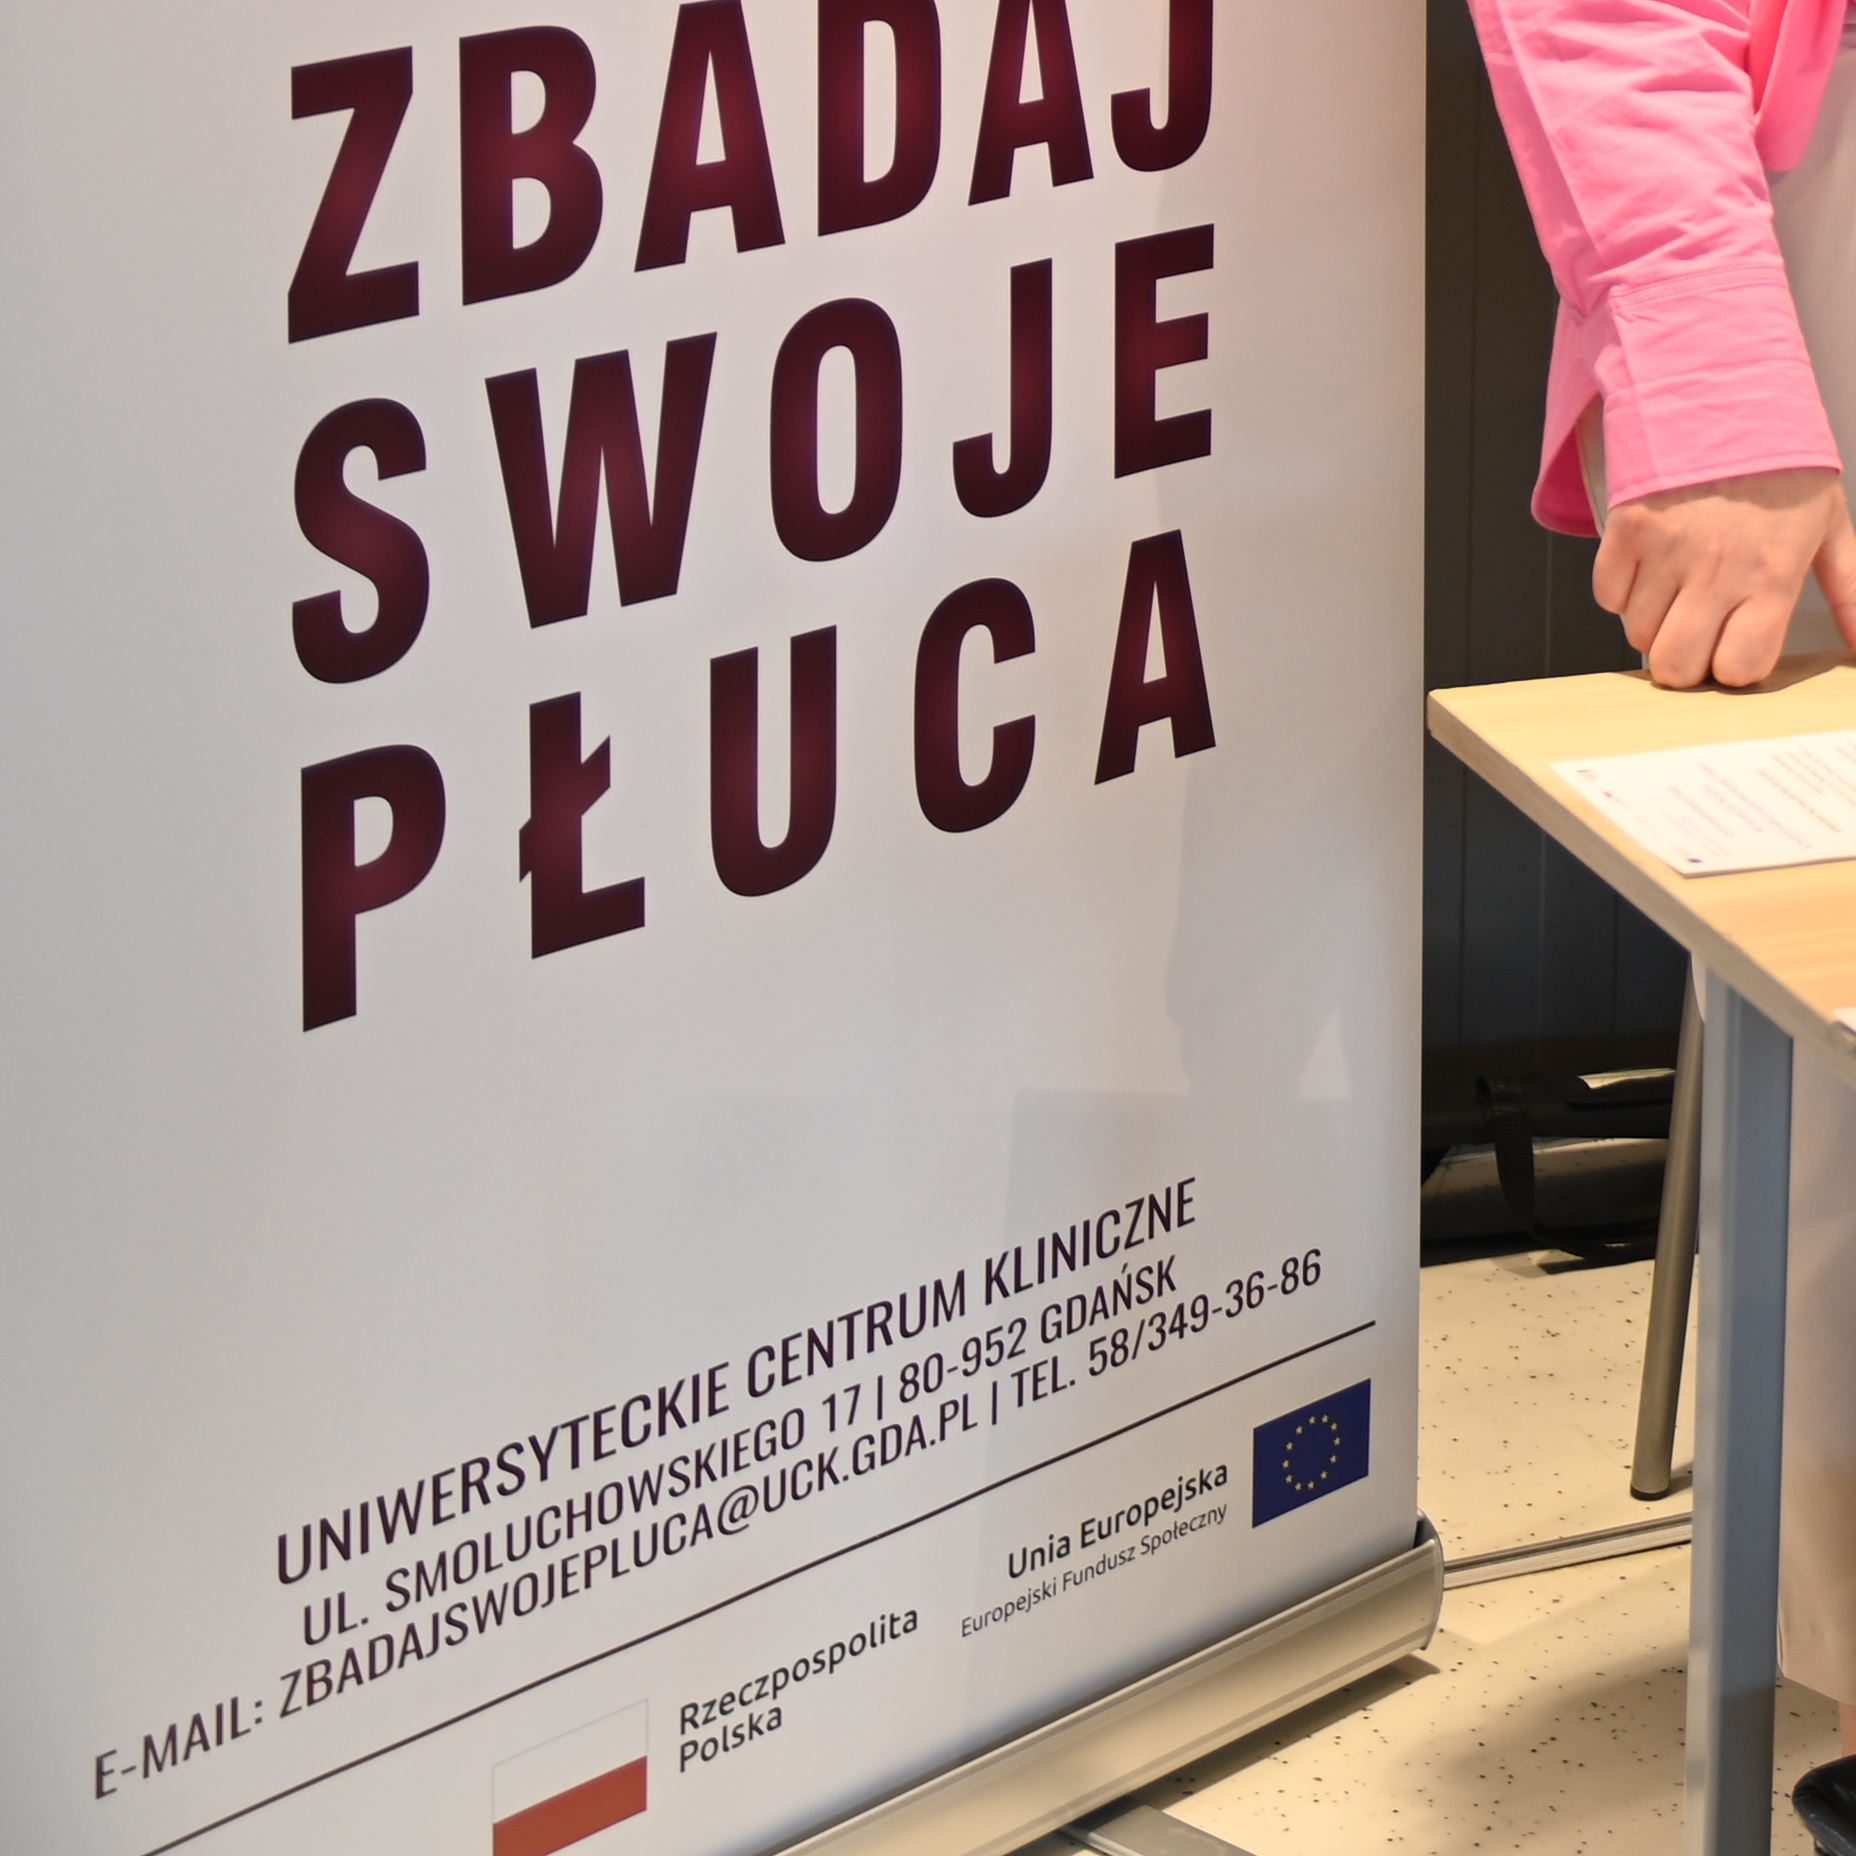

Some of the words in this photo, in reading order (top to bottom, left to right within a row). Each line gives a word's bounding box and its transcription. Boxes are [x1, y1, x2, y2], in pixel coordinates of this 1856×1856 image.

[292, 223, 1215, 685] SWOJE
[300, 528, 1217, 1034] PŁUCA
[94, 1693, 264, 1801] E-MAIL:
[279, 1392, 979, 1719] ZBADAJSWOJEPLUCA@UCK.GDA.PL
[1010, 1354, 1078, 1410] TEL.
[1087, 1247, 1323, 1376] 58/349-36-86
[276, 1361, 730, 1586] UNIWERSYTECKIE
[747, 1269, 968, 1398] CENTRUM
[984, 1176, 1197, 1305] KLINICZNE
[302, 1590, 370, 1646] UL.
[385, 1406, 805, 1613] SMOLUCHOWSKIEGO
[822, 1384, 863, 1434] 17
[899, 1316, 1028, 1404] 80-952
[1040, 1254, 1179, 1343] GDAŃSK
[961, 1578, 1058, 1638] Europejski
[1061, 1543, 1136, 1591] Fundusz
[1139, 1503, 1228, 1558] Społeczny
[1007, 1533, 1071, 1580] Unia
[1079, 1464, 1230, 1553] Europejska
[678, 1606, 919, 1735] Rzeczpospolita
[679, 1705, 783, 1774] Polska
